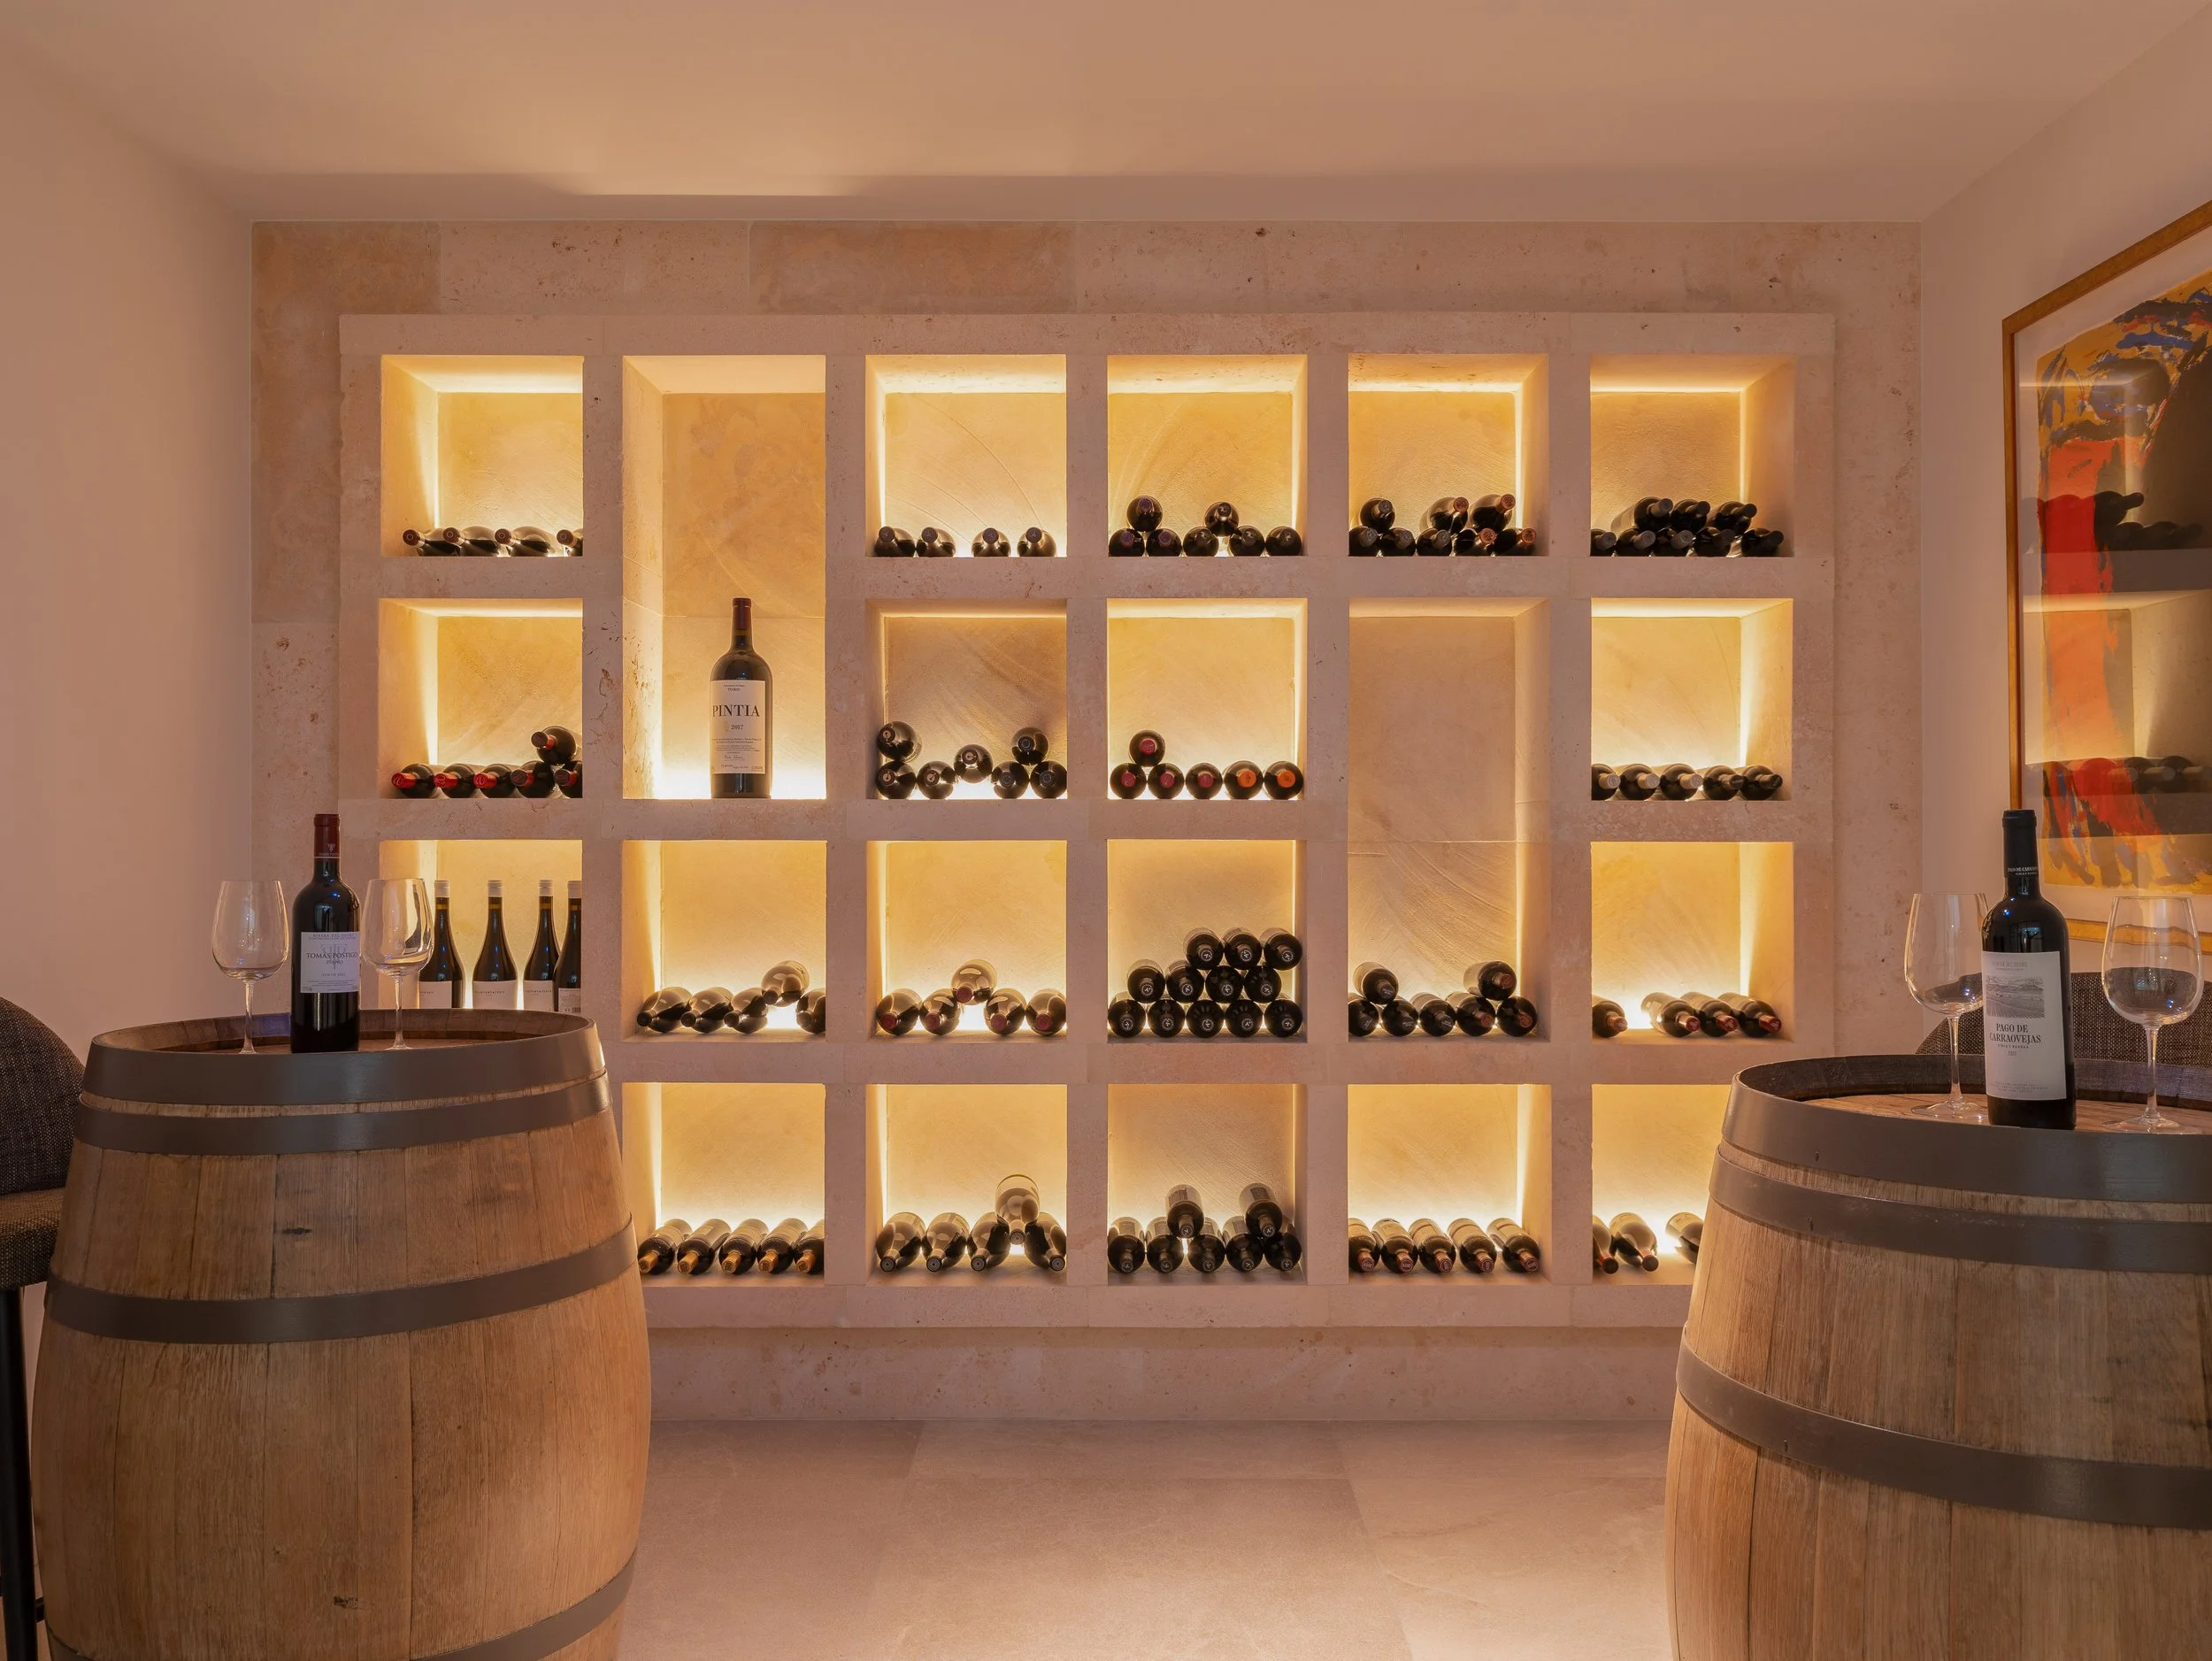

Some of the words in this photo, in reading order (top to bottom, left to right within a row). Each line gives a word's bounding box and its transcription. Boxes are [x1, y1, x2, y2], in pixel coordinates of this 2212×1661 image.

[712, 704, 760, 717] PINTIA
[1996, 1023, 2015, 1033] PAGO
[2016, 1024, 2029, 1033] DE
[1989, 1033, 2041, 1044] CARRAOVEJAS
